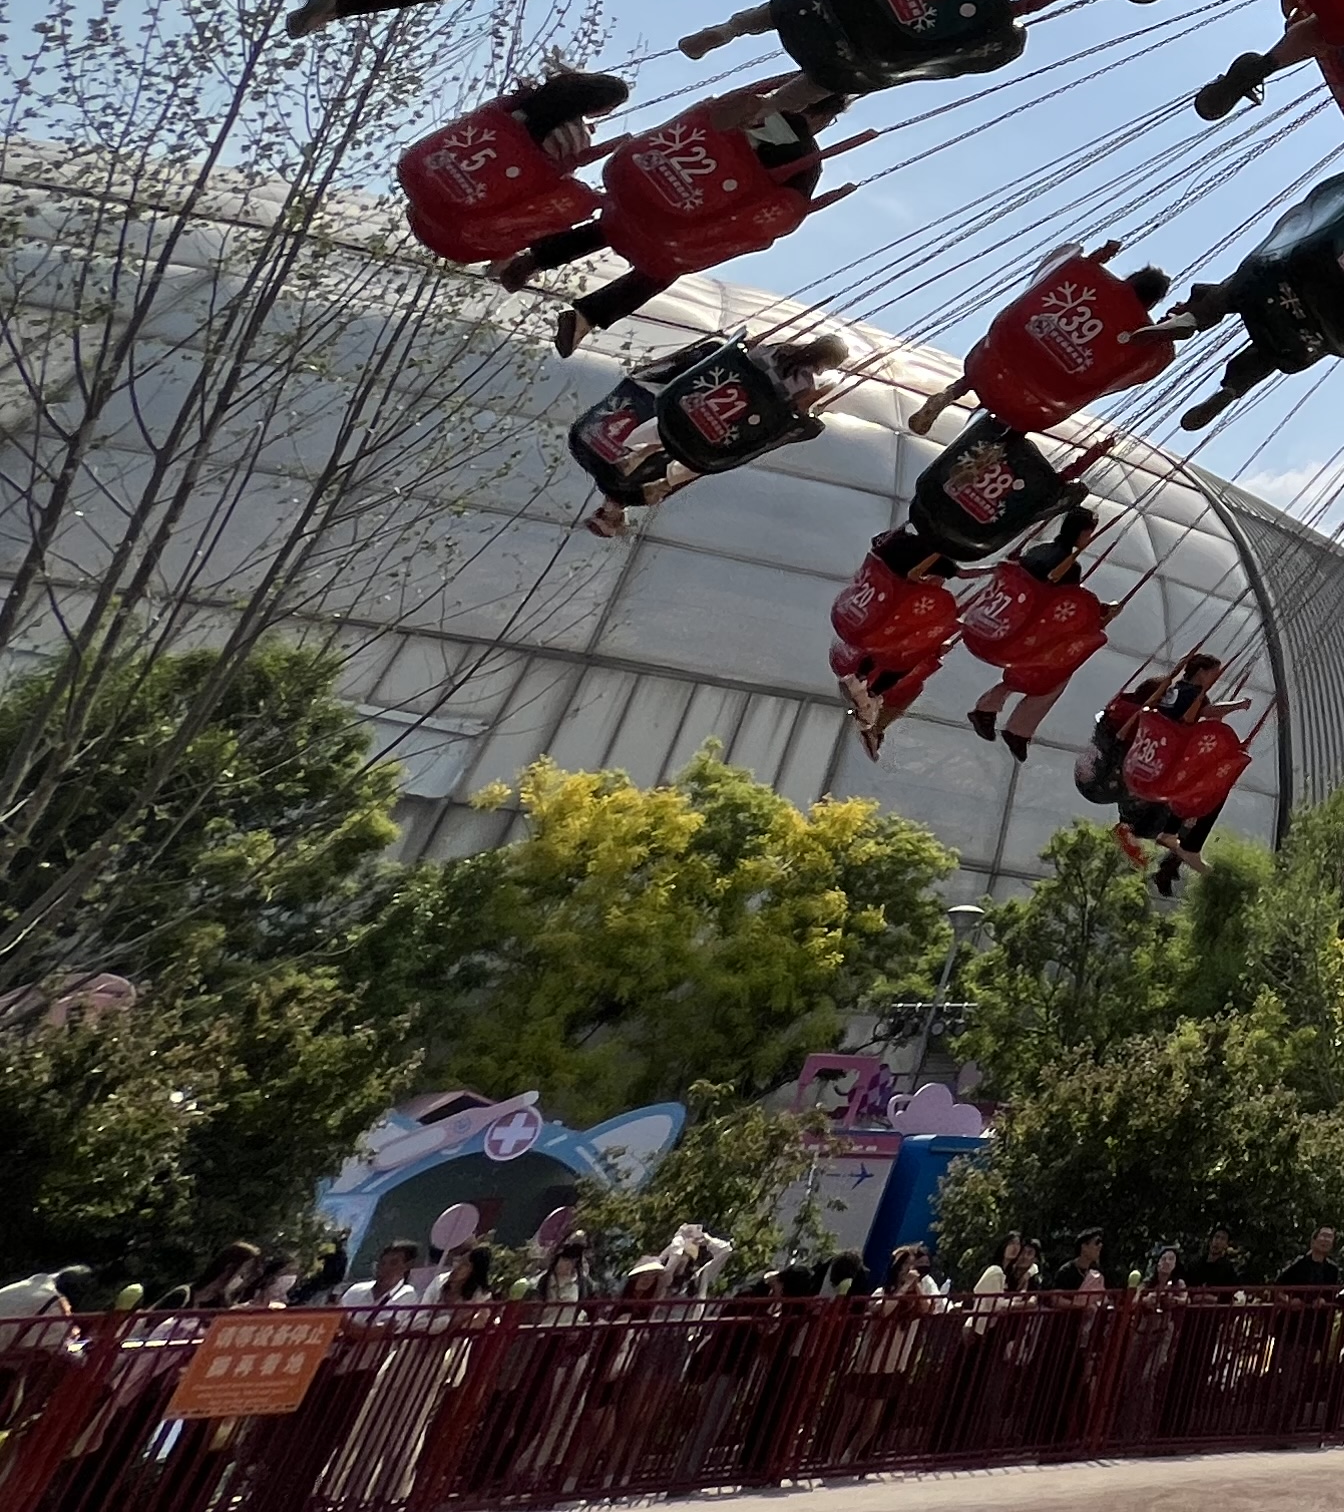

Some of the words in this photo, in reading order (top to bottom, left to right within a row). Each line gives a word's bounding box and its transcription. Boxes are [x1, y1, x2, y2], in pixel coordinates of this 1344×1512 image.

[460, 147, 497, 173] 5
[670, 146, 718, 184] 22
[1058, 305, 1104, 345] 39
[706, 388, 748, 420] 21
[973, 463, 1014, 500] 38
[852, 582, 876, 609] 20
[984, 591, 1013, 619] 37
[1138, 737, 1159, 764] 36
